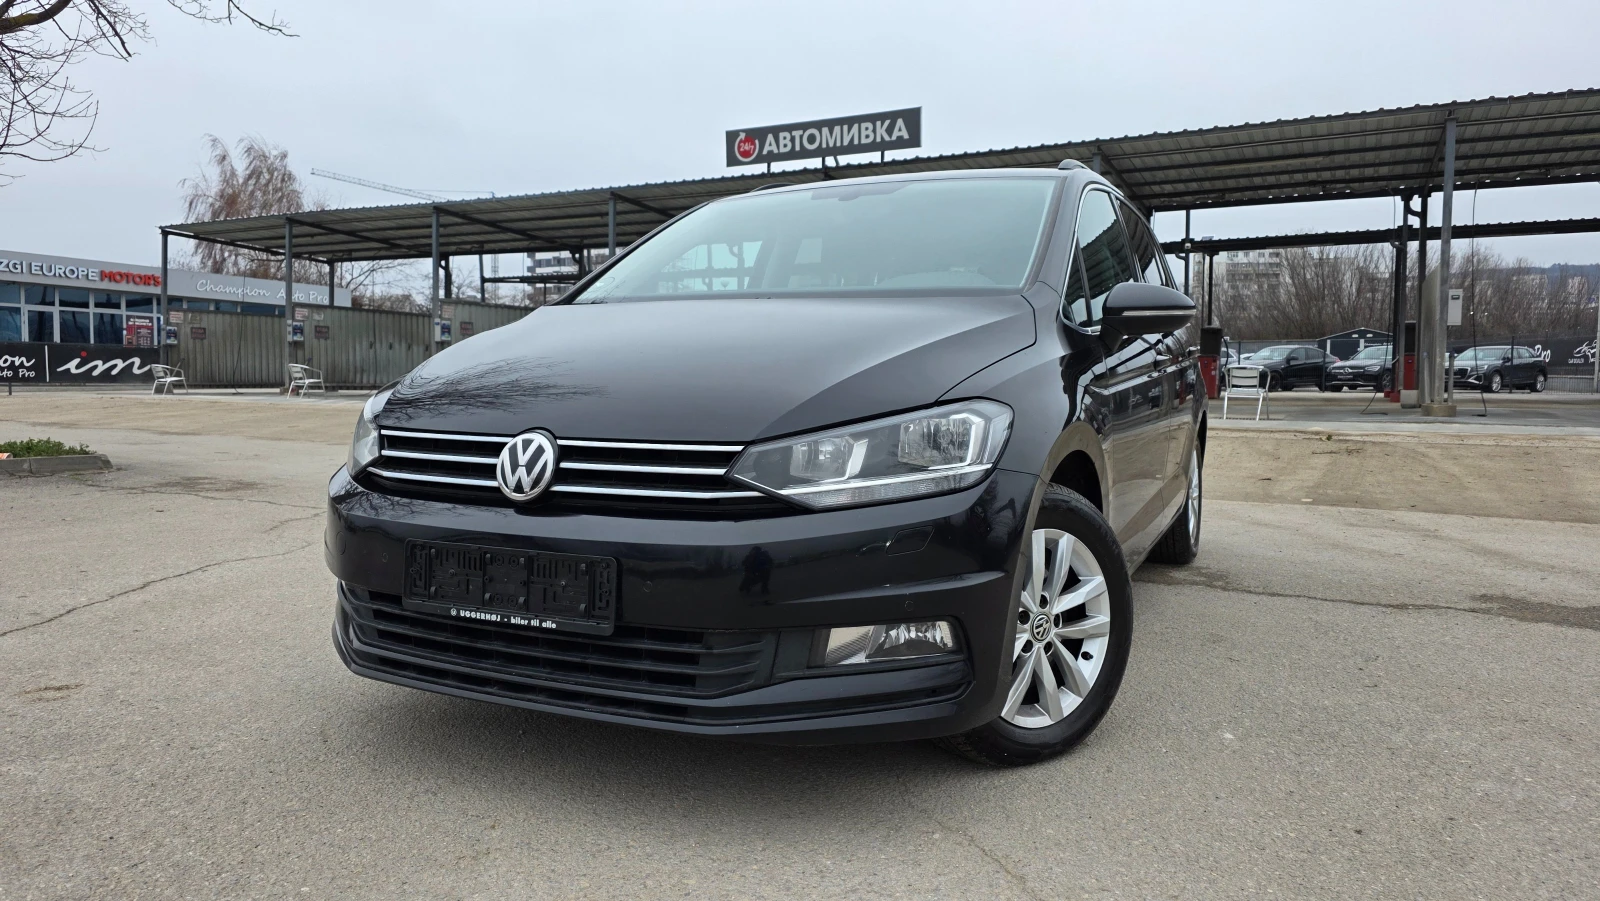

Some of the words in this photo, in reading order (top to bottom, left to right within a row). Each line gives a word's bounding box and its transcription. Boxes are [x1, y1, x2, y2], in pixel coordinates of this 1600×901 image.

[739, 141, 754, 154] 24/7
[762, 118, 910, 155] АВТОМИВКА
[31, 261, 99, 281] EUROPE
[196, 280, 271, 298] Champion
[277, 288, 305, 301] Ato
[309, 291, 330, 304] Pro
[19, 368, 36, 378] Pro
[460, 609, 501, 622] UGGERHØJ
[510, 616, 529, 626] biler
[531, 618, 540, 627] til
